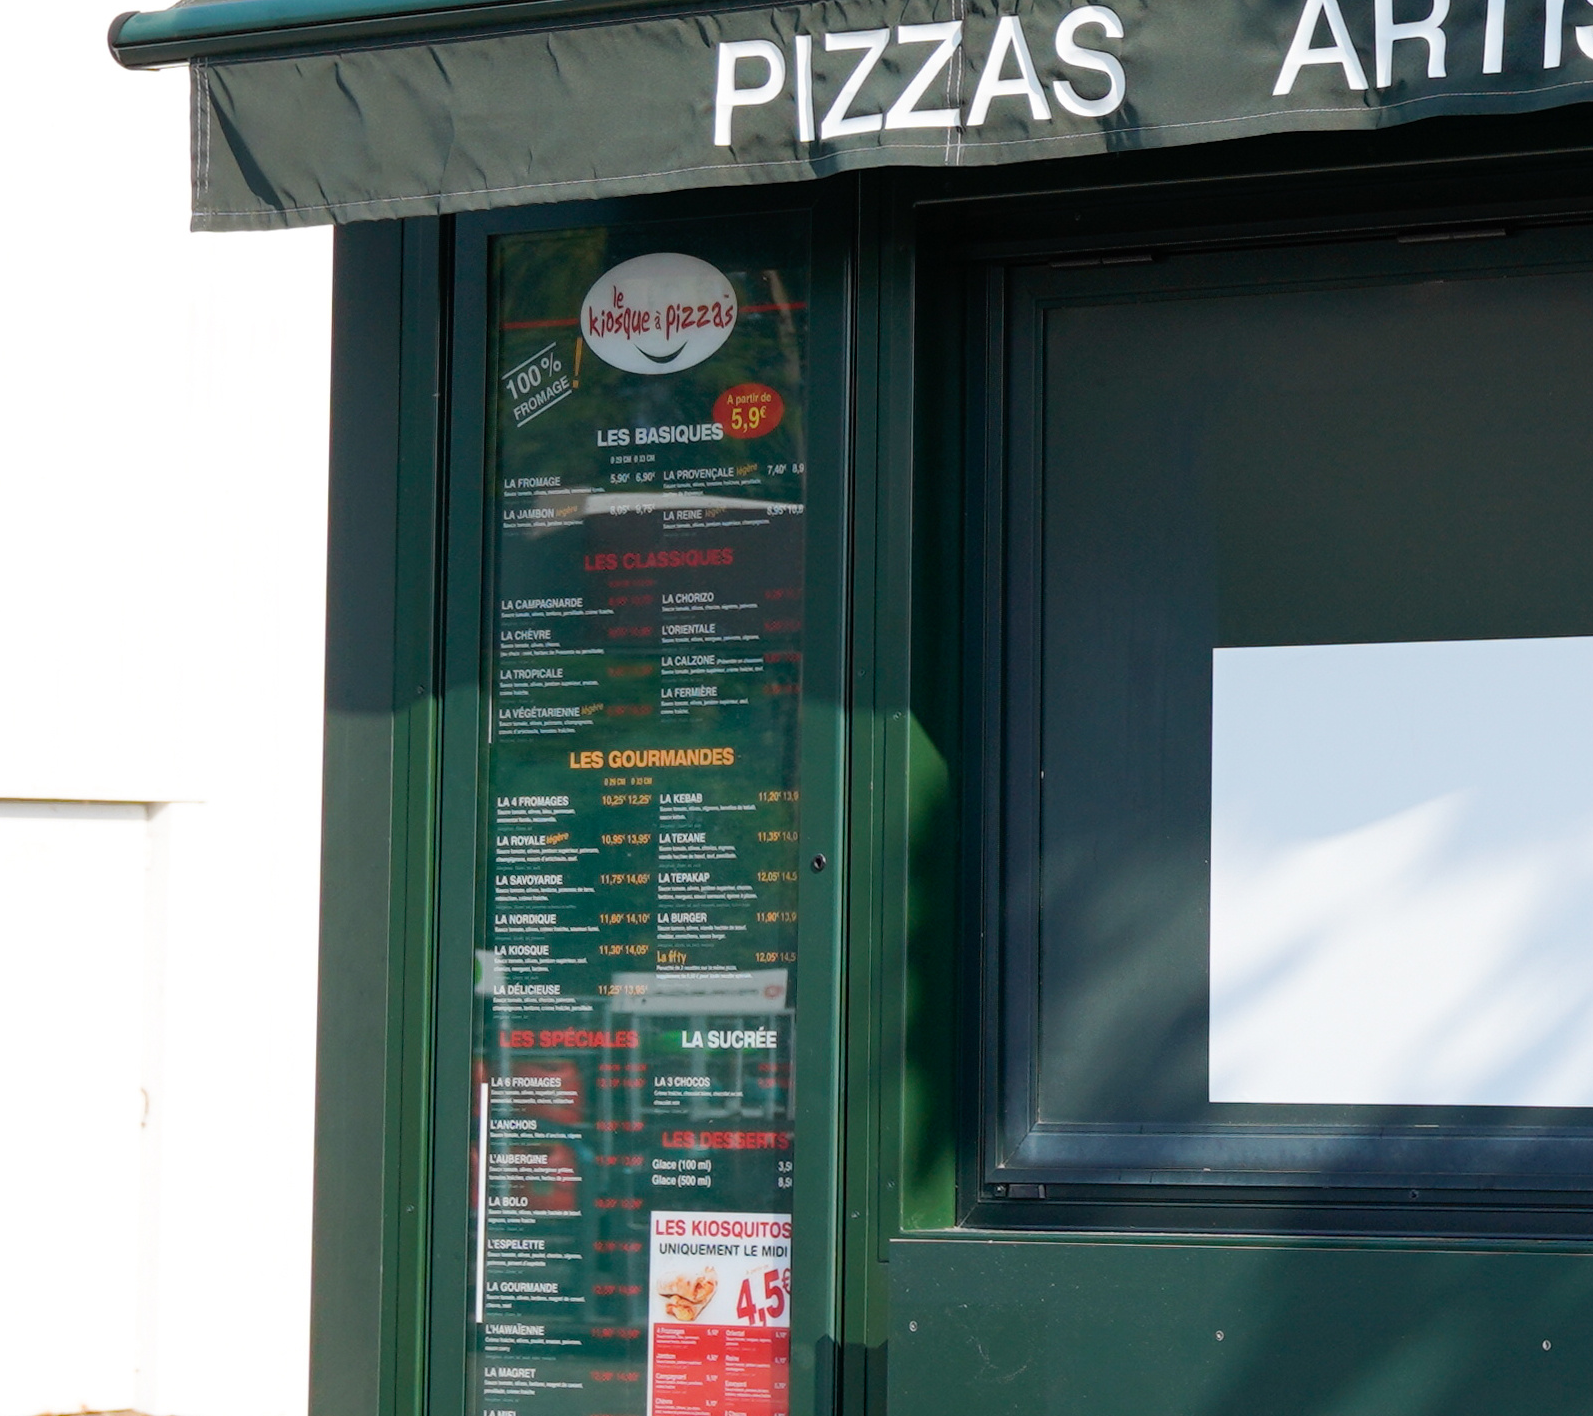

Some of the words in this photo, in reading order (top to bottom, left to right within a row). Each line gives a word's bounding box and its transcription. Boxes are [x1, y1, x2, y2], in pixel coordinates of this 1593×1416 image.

[714, 4, 1125, 148] PIZZAS
[613, 285, 624, 309] le
[589, 306, 650, 340] kiosque
[654, 311, 662, 330] à
[665, 301, 733, 340] pizzas
[506, 368, 541, 400] 100
[543, 351, 562, 378] %
[513, 375, 570, 421] FROMAGE
[727, 394, 734, 405] A
[735, 392, 759, 406] partir
[760, 392, 771, 402] de
[730, 405, 767, 433] 5,9€
[597, 429, 630, 447] LES
[635, 422, 724, 445] BASIQUES
[663, 470, 675, 481] LA
[676, 467, 734, 481] PROVENÇALE
[584, 553, 618, 572] LES
[622, 548, 734, 571] CLASSIQUES
[661, 623, 716, 635] L'ORIENTALE
[569, 750, 604, 769] LES
[608, 747, 735, 768] GOURMANDES
[499, 1030, 534, 1048] LES
[539, 1026, 639, 1048] SPÉCIALES
[681, 1030, 704, 1049] LA
[706, 1026, 777, 1049] SUCRÉE
[661, 1131, 695, 1148] LES
[699, 1131, 790, 1150] DESSERTS
[655, 1219, 686, 1236] LES
[691, 1220, 792, 1239] KIOSQUITOS
[659, 1242, 740, 1257] UNIQUEMENT
[744, 1244, 758, 1257] LE
[761, 1245, 788, 1258] MIDI
